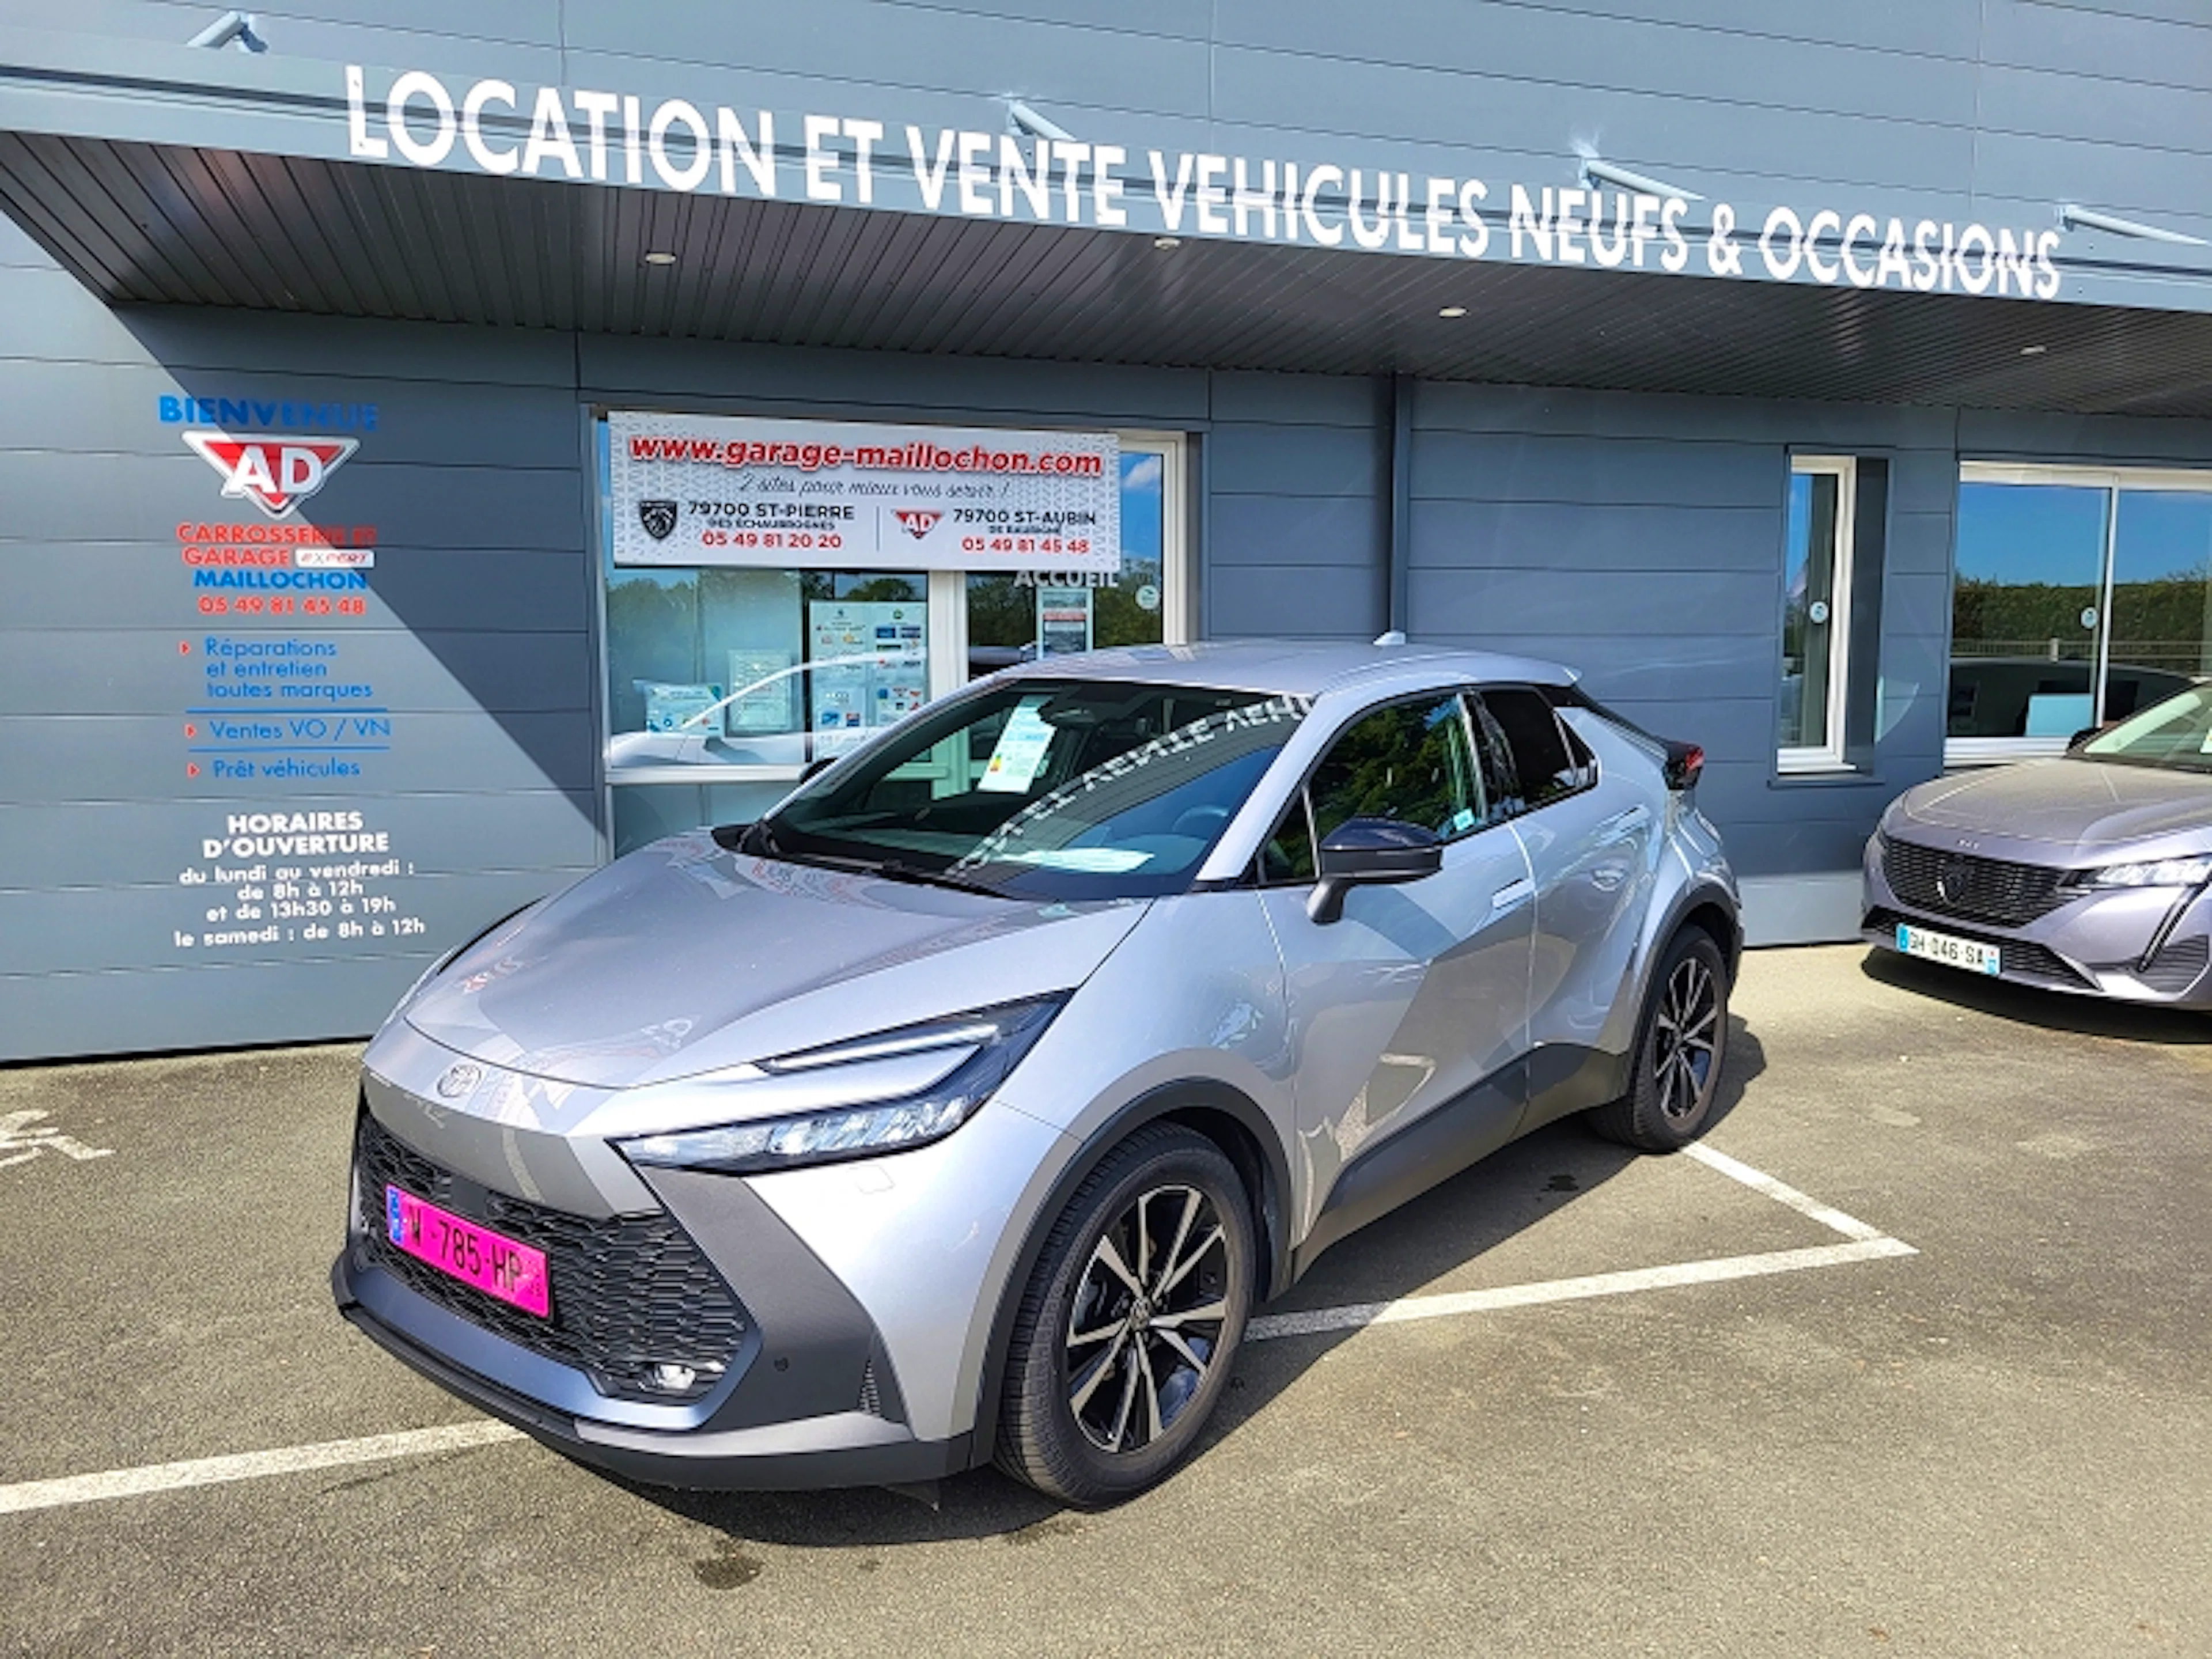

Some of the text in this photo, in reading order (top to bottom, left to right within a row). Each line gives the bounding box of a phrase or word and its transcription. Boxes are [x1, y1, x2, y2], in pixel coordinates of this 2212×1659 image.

[346, 65, 2060, 300] LOCATION ET VENTE VEHICULES NEUFS & OCCASIONS
[158, 395, 378, 431] BIENVENUE
[630, 435, 1103, 477] www.garage-maillochon.com
[230, 445, 323, 494] AD
[740, 472, 755, 492] 2
[905, 482, 941, 496] vous
[688, 501, 749, 516] 79700
[756, 503, 855, 520] ST-PIERRE
[953, 509, 1096, 525] 79700 ST-AUBIN
[905, 513, 934, 531] AD
[177, 524, 377, 545] CARROSSERIE ET
[702, 531, 842, 548] 05 49 81 20 20
[962, 537, 1090, 554] 05 49 81 45 48
[182, 548, 288, 568] GARAGE
[194, 570, 366, 590] MAILLOCHON
[1014, 570, 1119, 588] ACCUEIL
[198, 595, 365, 615] 05 49 81 45 48
[205, 637, 337, 660] Réparations
[206, 661, 327, 677] et entretien
[207, 682, 373, 702] toutes marques
[210, 718, 391, 741] Ventes VO / VN
[213, 758, 359, 778] Prêt véhicules
[228, 812, 363, 834] HORAIRES
[203, 833, 390, 858] D'OUVERTURE
[179, 868, 206, 885] du
[215, 865, 267, 882] lundi
[275, 866, 301, 881] au
[309, 860, 399, 879] vendredi
[237, 880, 363, 900] de 8h à 12h
[206, 897, 396, 922] et de 13h30 à 19h
[175, 930, 194, 946] le
[204, 926, 280, 946] samedi
[304, 924, 328, 941] de
[338, 921, 363, 938] 8h
[372, 919, 384, 936] à
[392, 918, 425, 935] 12h
